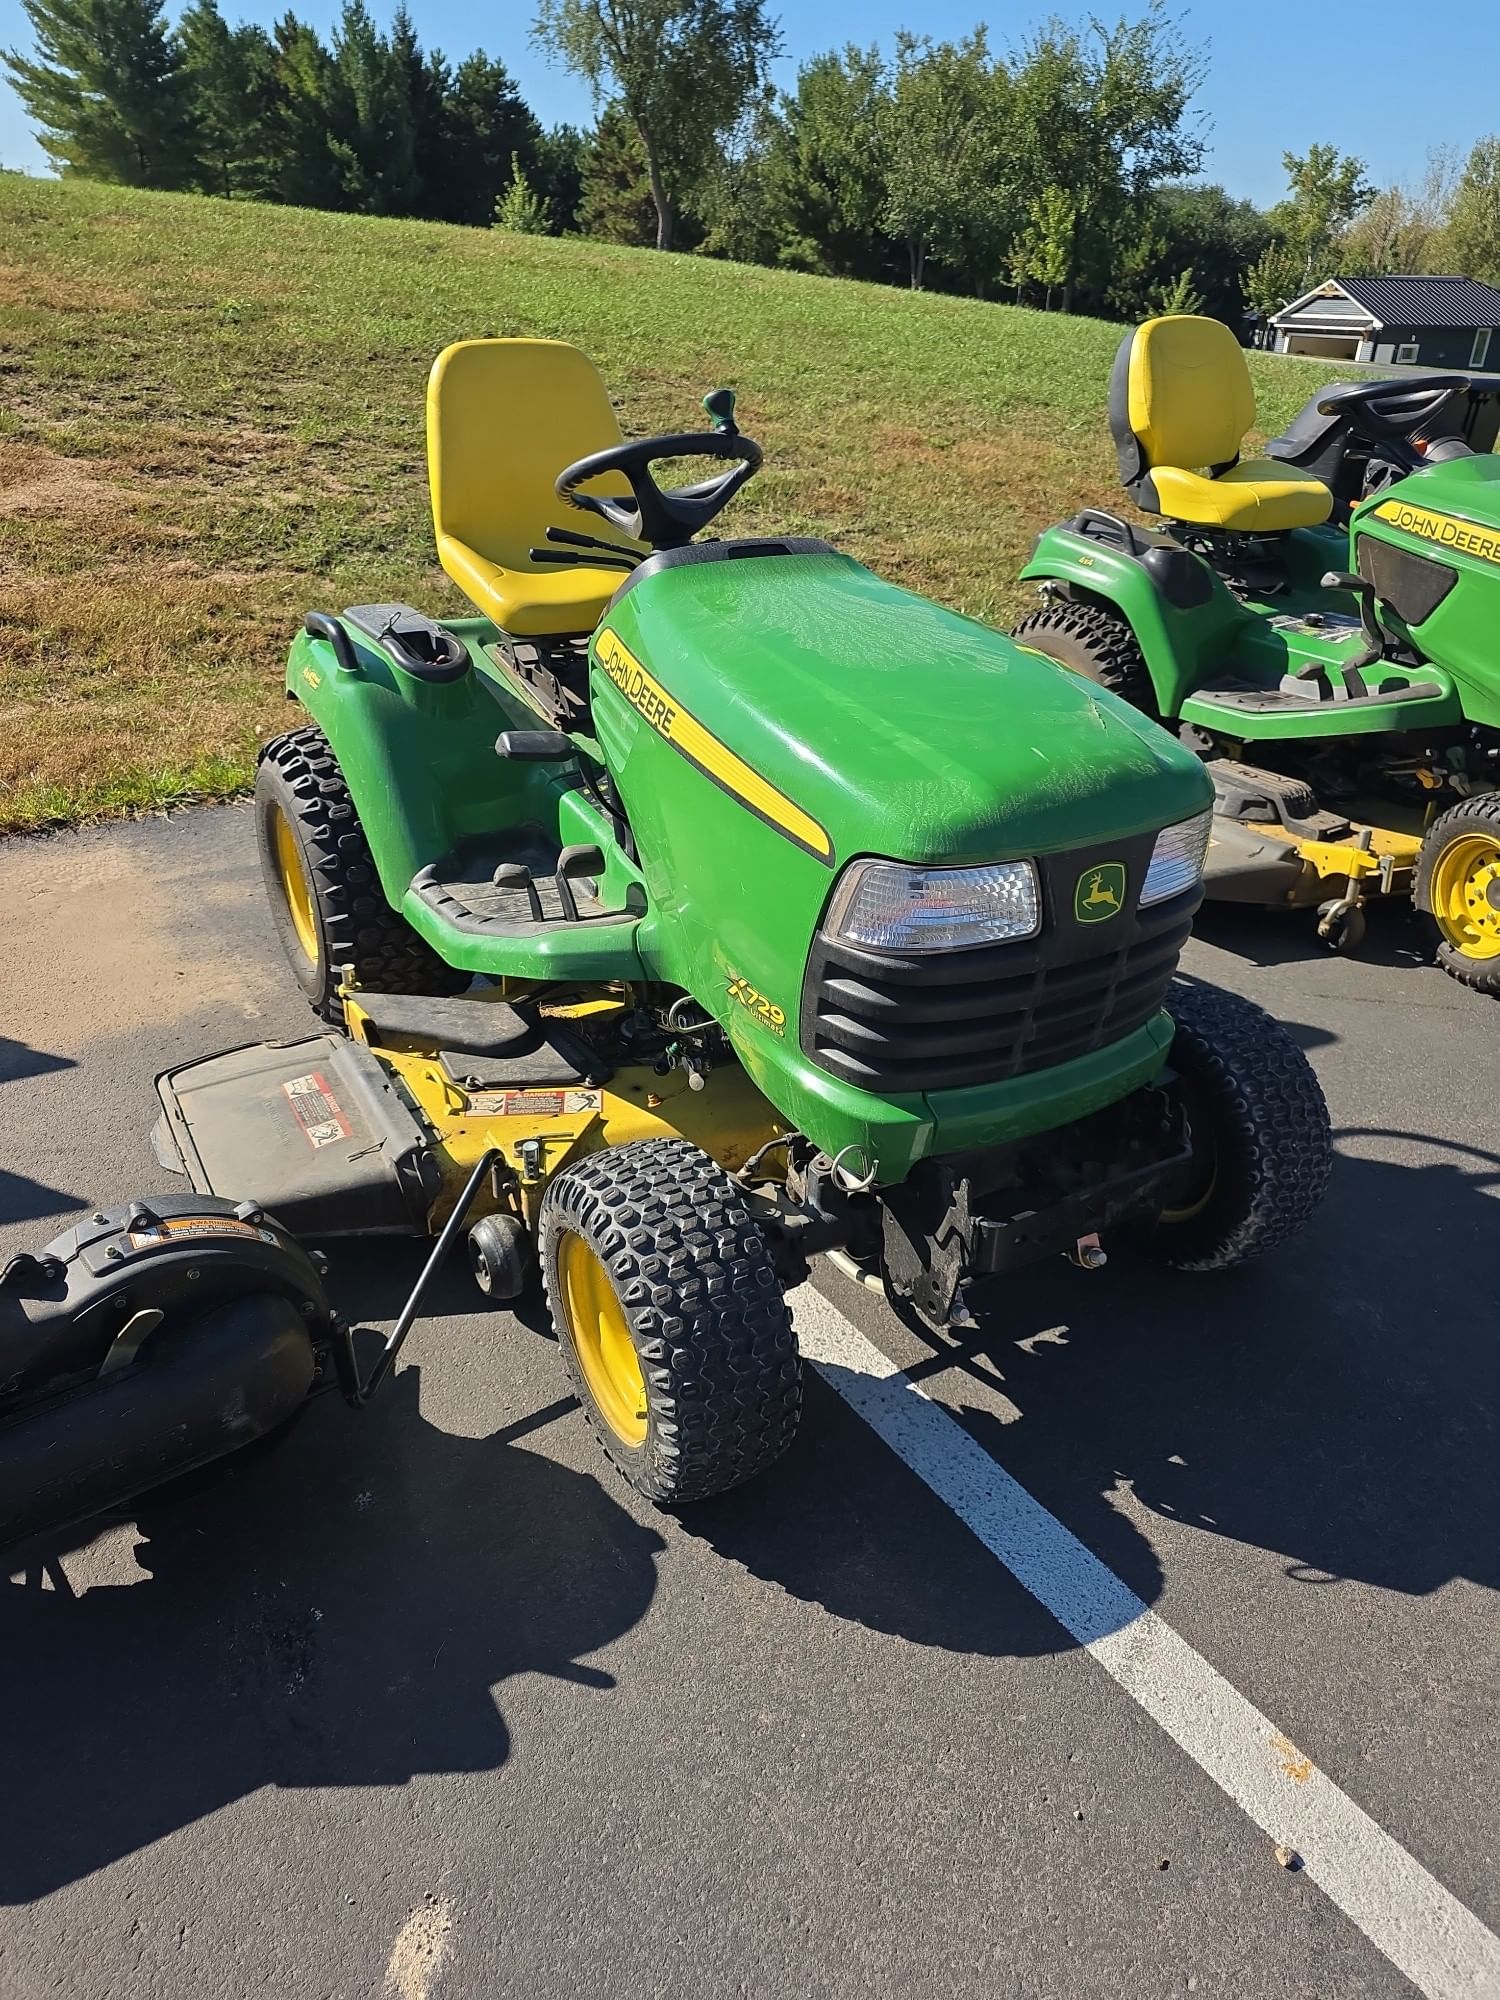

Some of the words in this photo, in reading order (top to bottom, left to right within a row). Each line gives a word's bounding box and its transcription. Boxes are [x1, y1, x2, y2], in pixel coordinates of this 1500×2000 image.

[1390, 506, 1438, 537] JOHN
[604, 643, 632, 690] JOHN
[630, 670, 676, 734] DEERE
[725, 976, 786, 1026] X729
